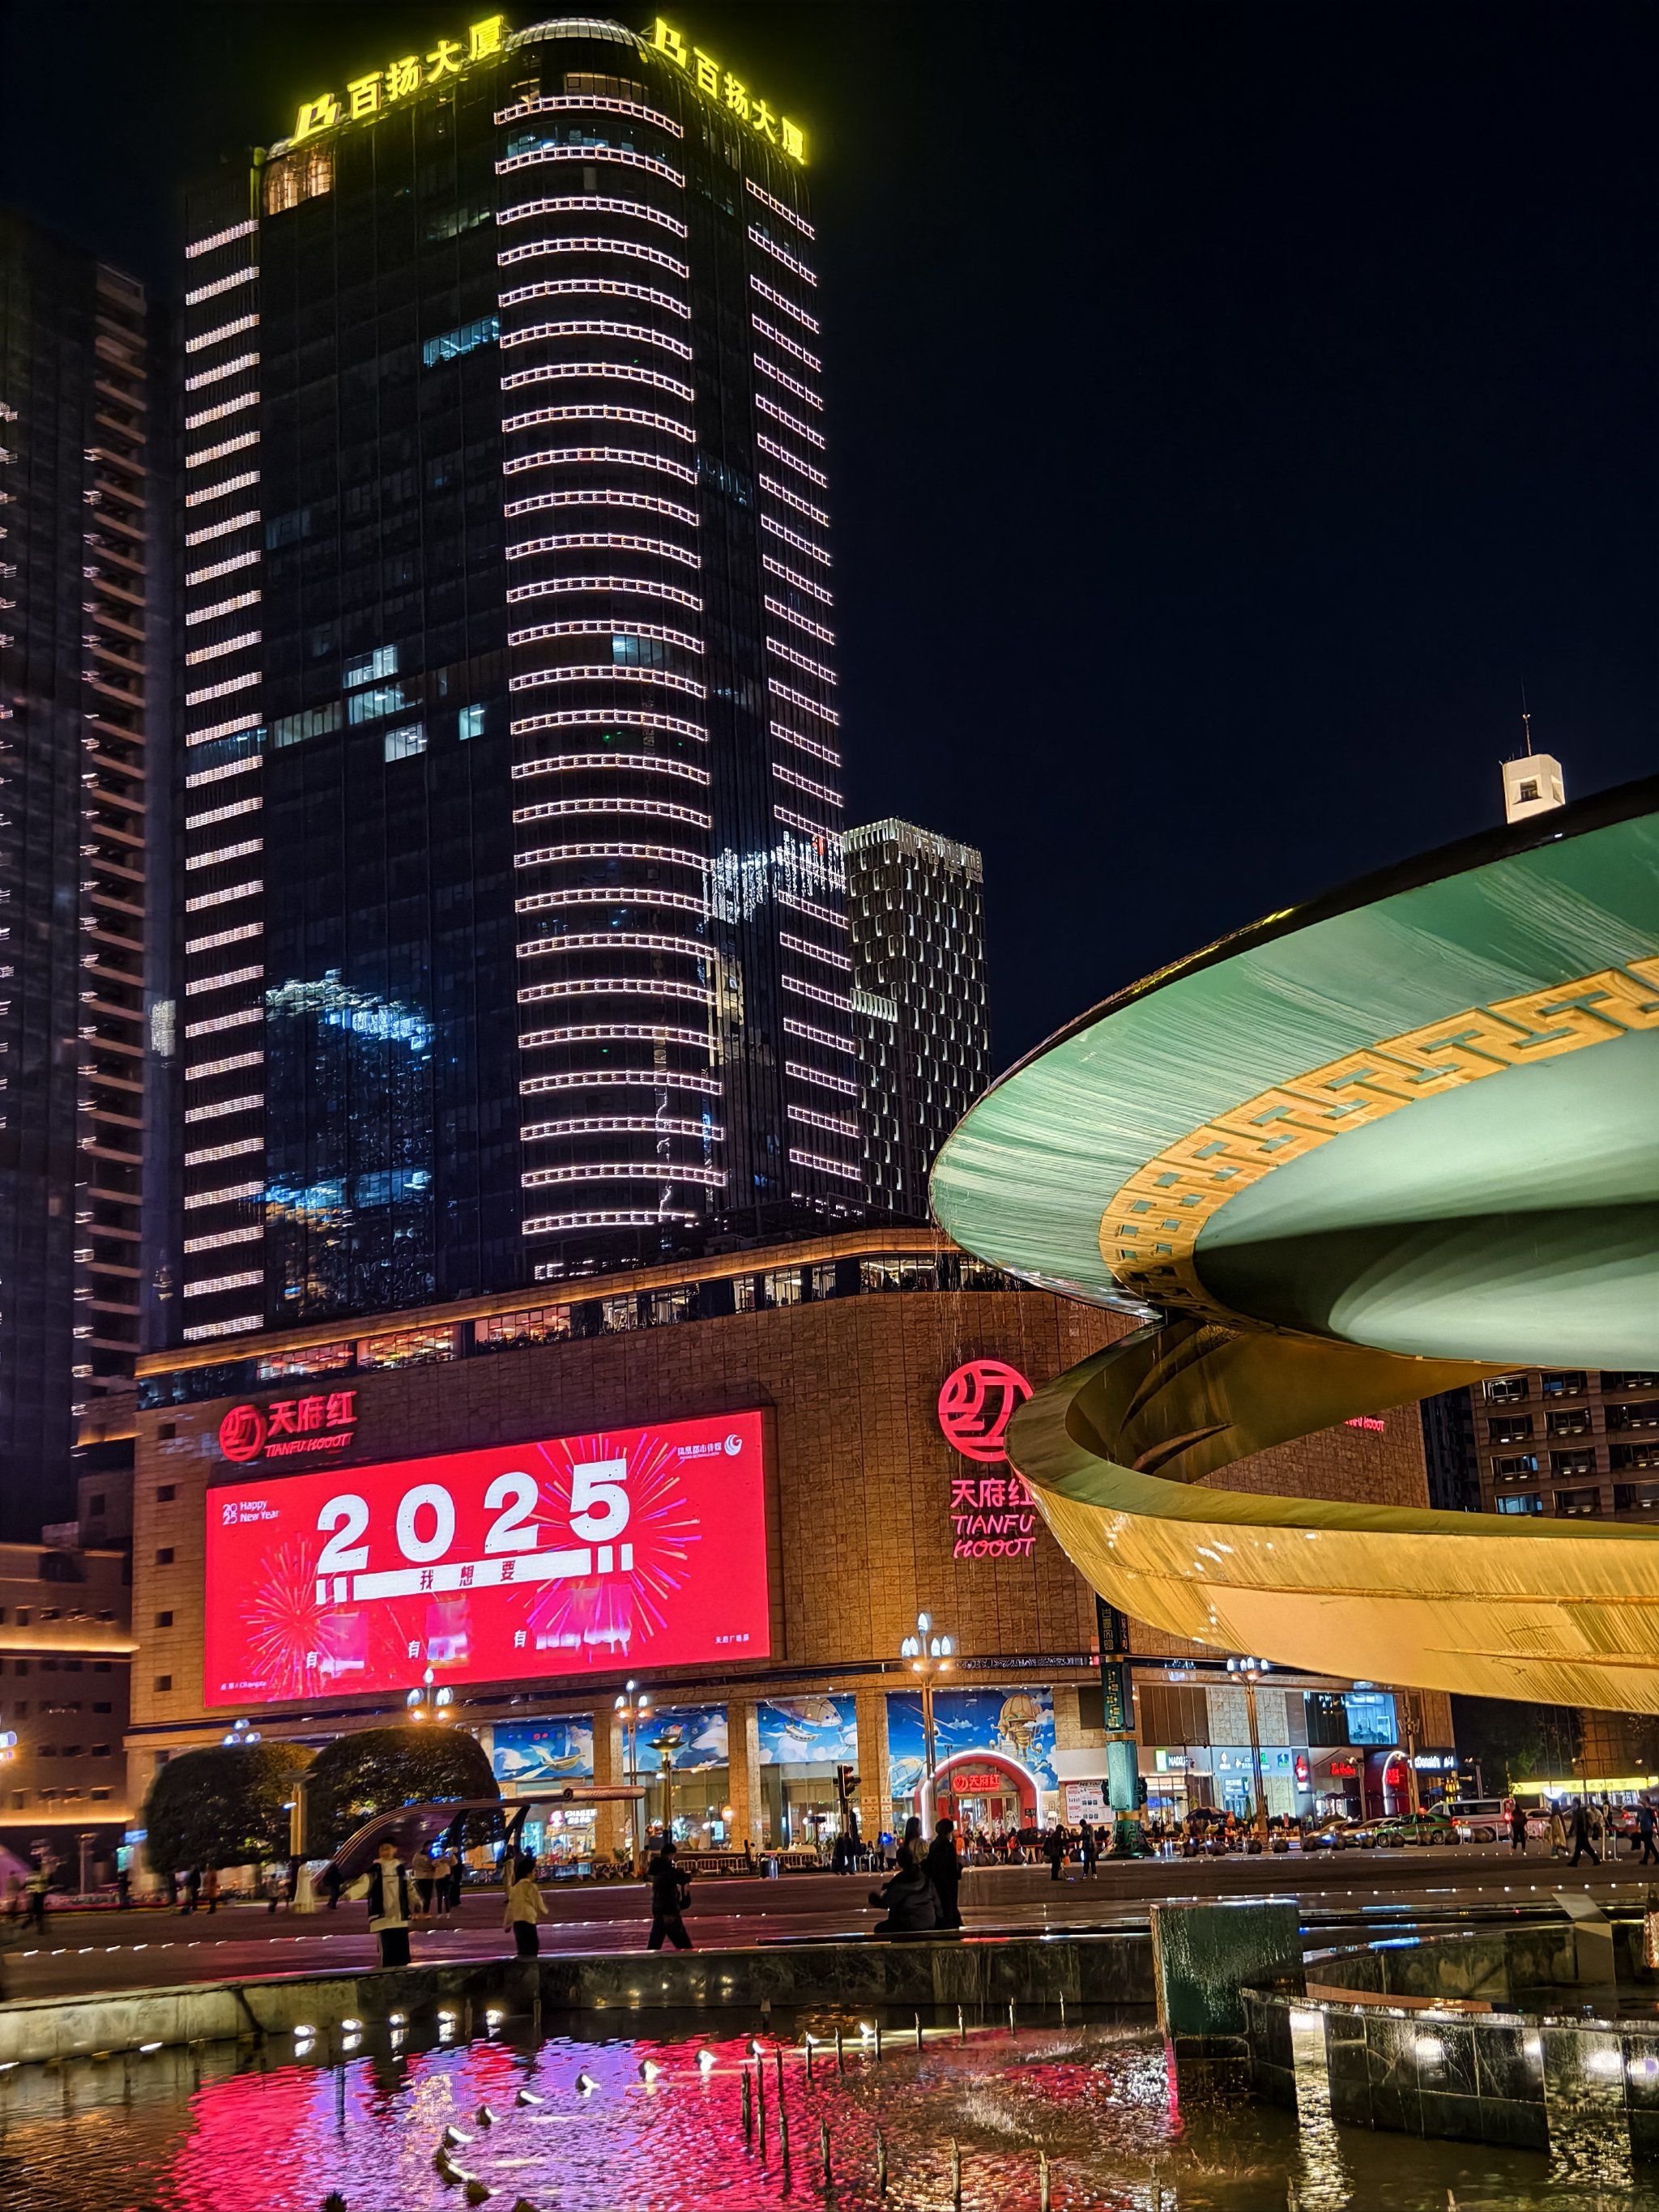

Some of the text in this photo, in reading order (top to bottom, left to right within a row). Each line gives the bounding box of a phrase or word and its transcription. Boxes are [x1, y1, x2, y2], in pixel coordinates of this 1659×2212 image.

[347, 15, 504, 120] 百扬大厦
[693, 46, 805, 165] 百扬大厦
[267, 1390, 357, 1437] 天府红
[240, 1500, 268, 1511] Happy
[240, 1510, 279, 1522] New Year
[317, 1458, 630, 1575] 2025
[950, 1515, 1036, 1535] TIANFU
[420, 1559, 516, 1591] 我想要
[306, 1651, 318, 1669] 有
[407, 1639, 420, 1659] 有
[514, 1630, 527, 1649] 有
[969, 1774, 1000, 1786] 天府红
